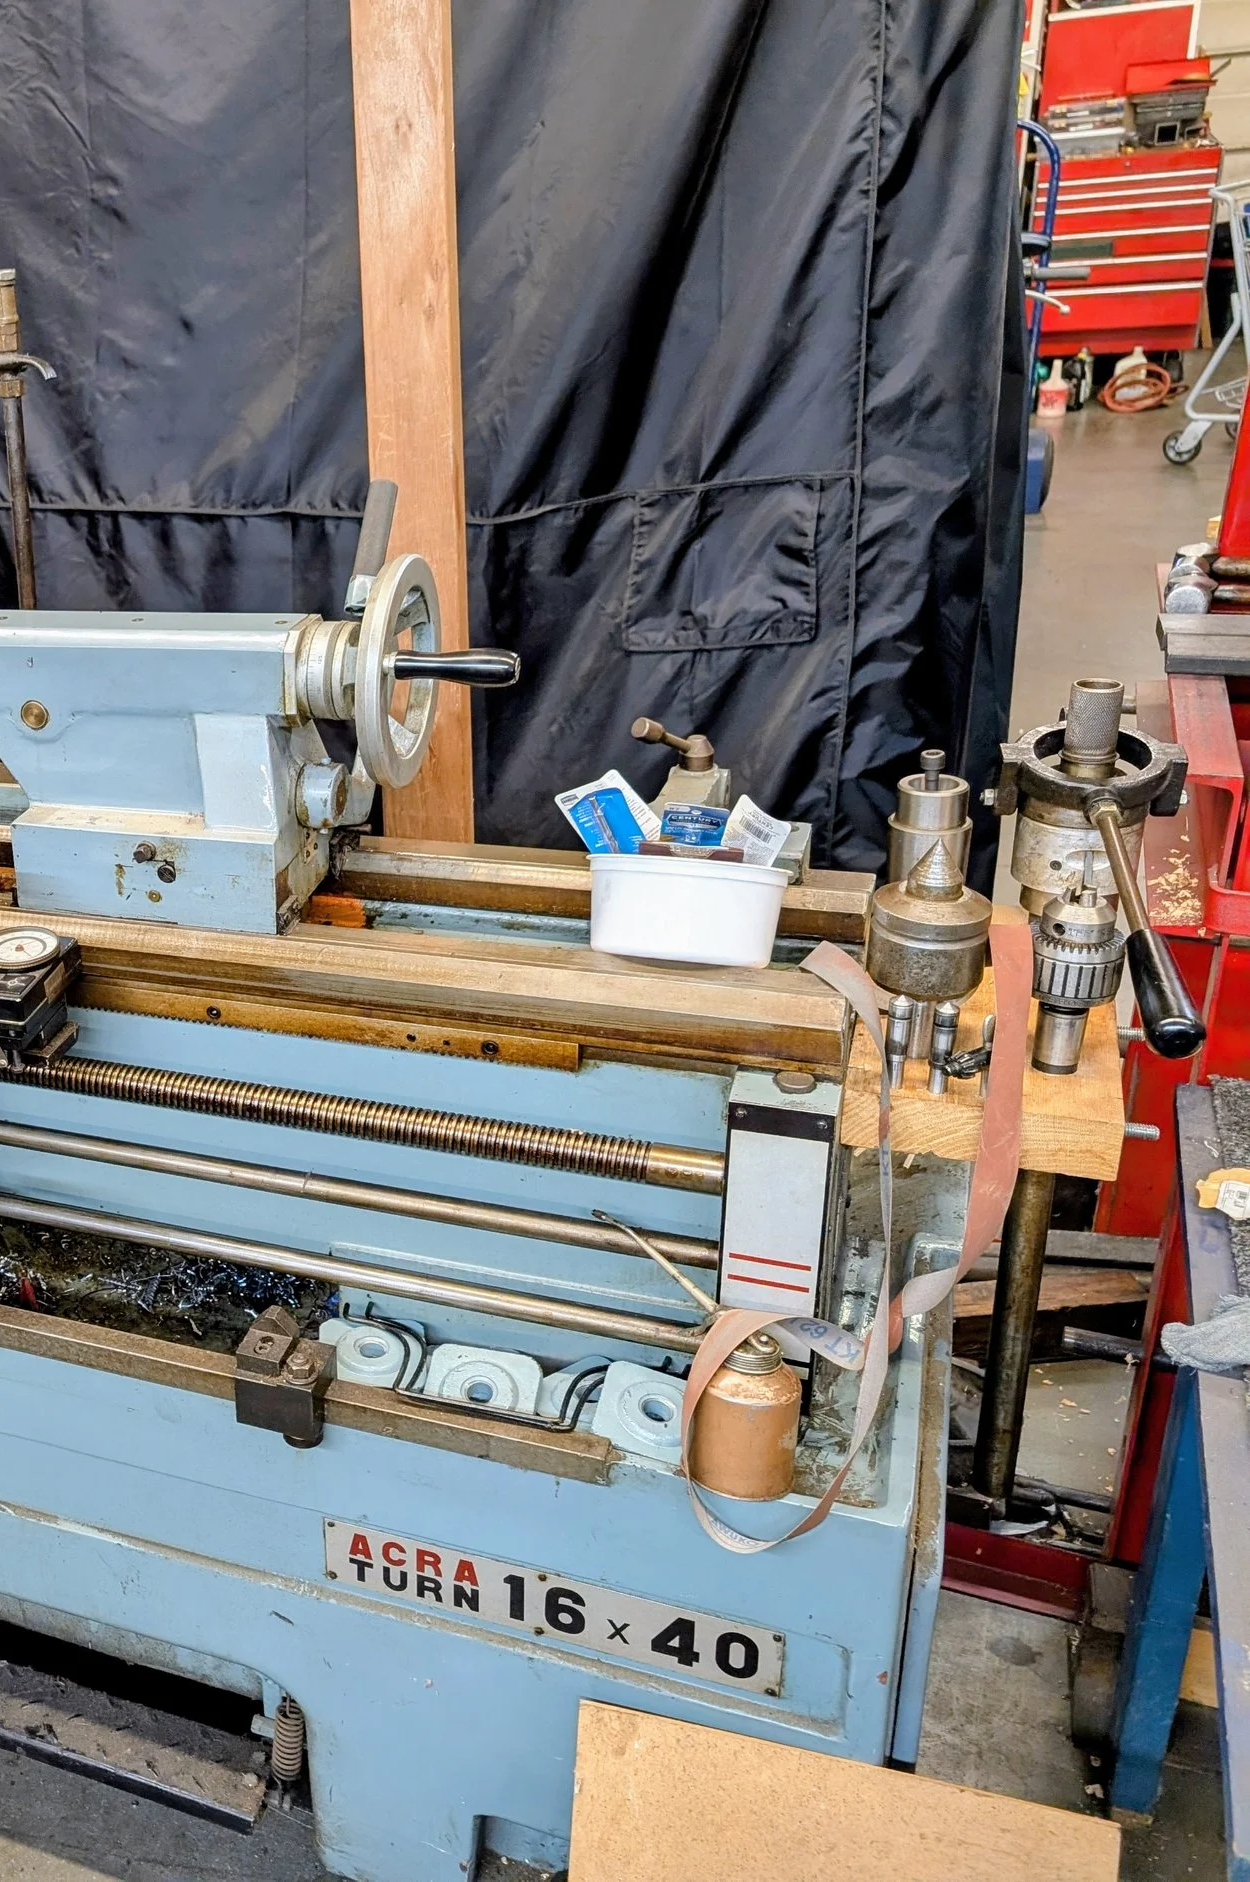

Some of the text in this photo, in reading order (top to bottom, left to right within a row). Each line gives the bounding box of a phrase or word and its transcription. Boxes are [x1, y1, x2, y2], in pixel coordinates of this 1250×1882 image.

[671, 815, 718, 823] CENTURY
[348, 1532, 480, 1588] ACRA
[348, 1556, 481, 1613] TURN
[503, 1573, 587, 1635] 16
[650, 1616, 760, 1679] 40
